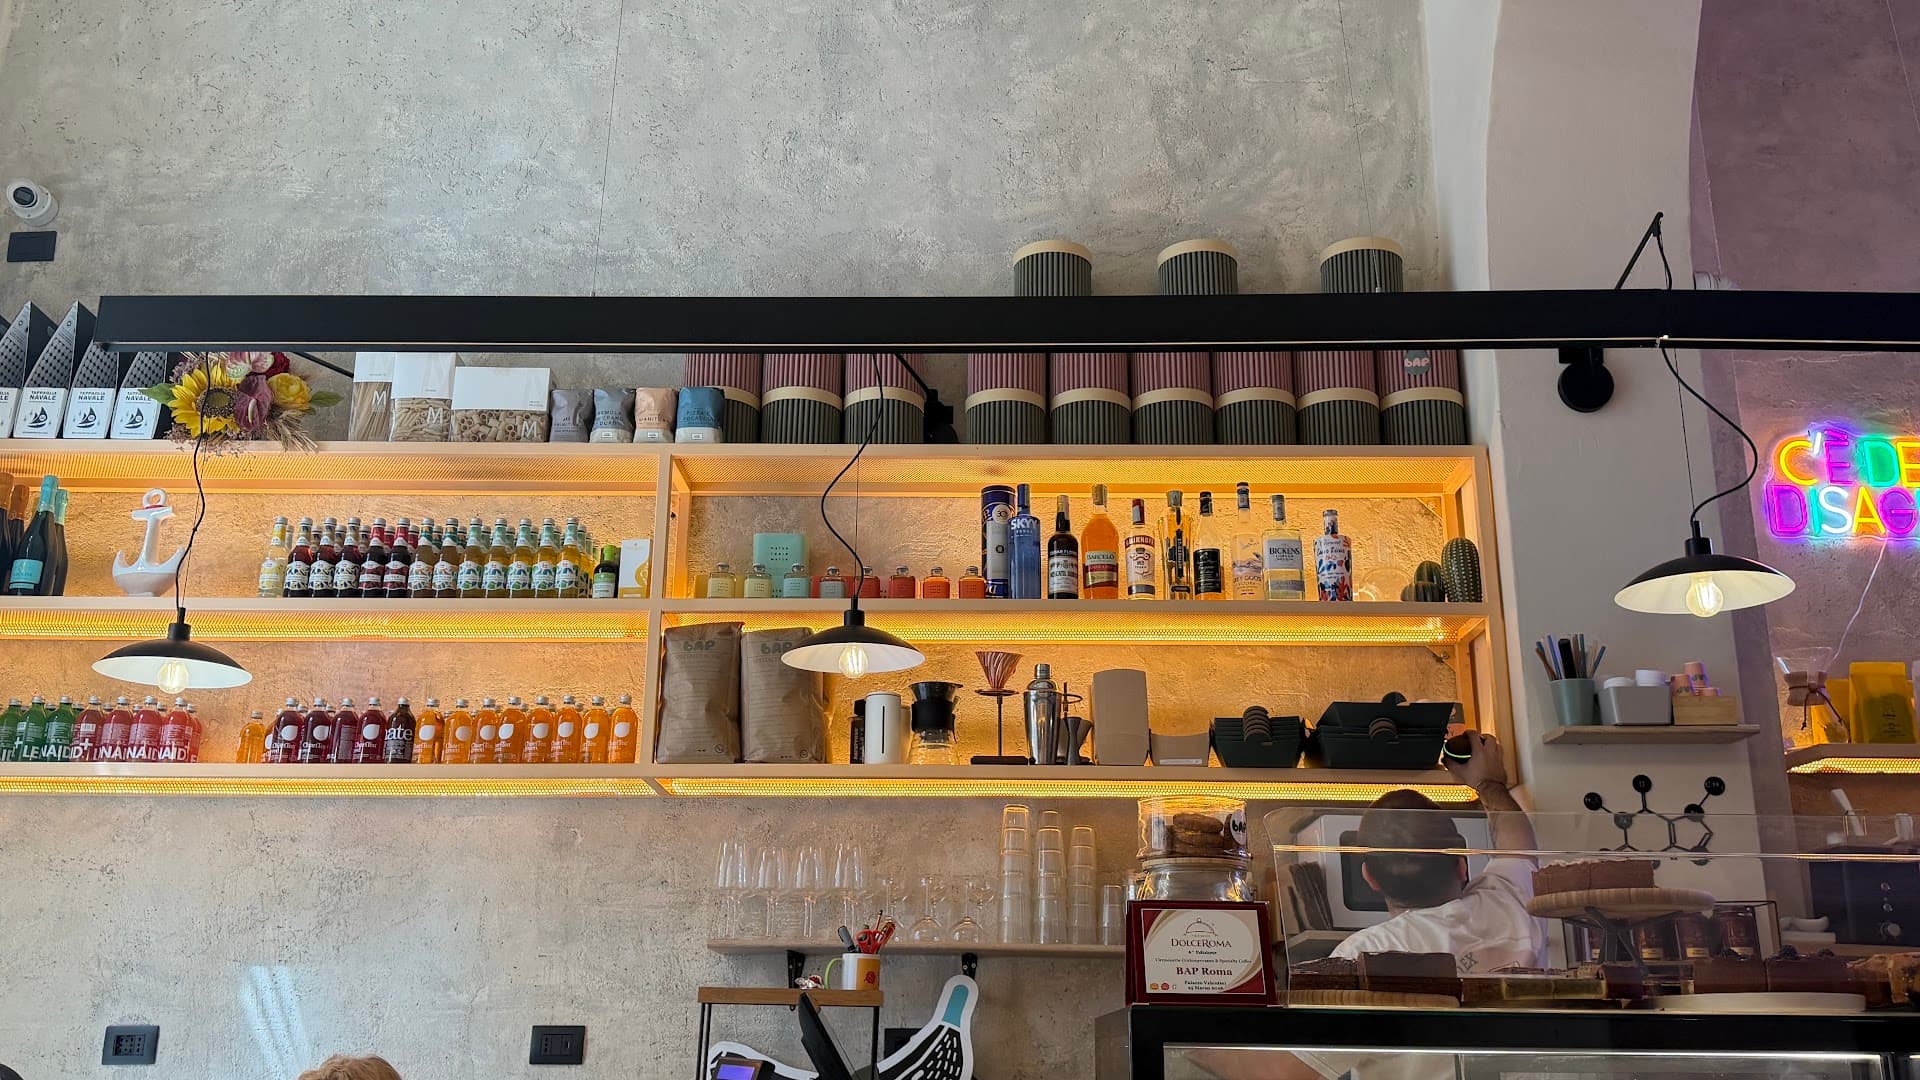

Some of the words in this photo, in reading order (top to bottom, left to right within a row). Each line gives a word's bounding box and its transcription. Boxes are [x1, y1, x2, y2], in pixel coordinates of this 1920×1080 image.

[1010, 518, 1038, 530] SKYY
[1176, 966, 1199, 975] BAP
[1201, 967, 1233, 976] Roma
